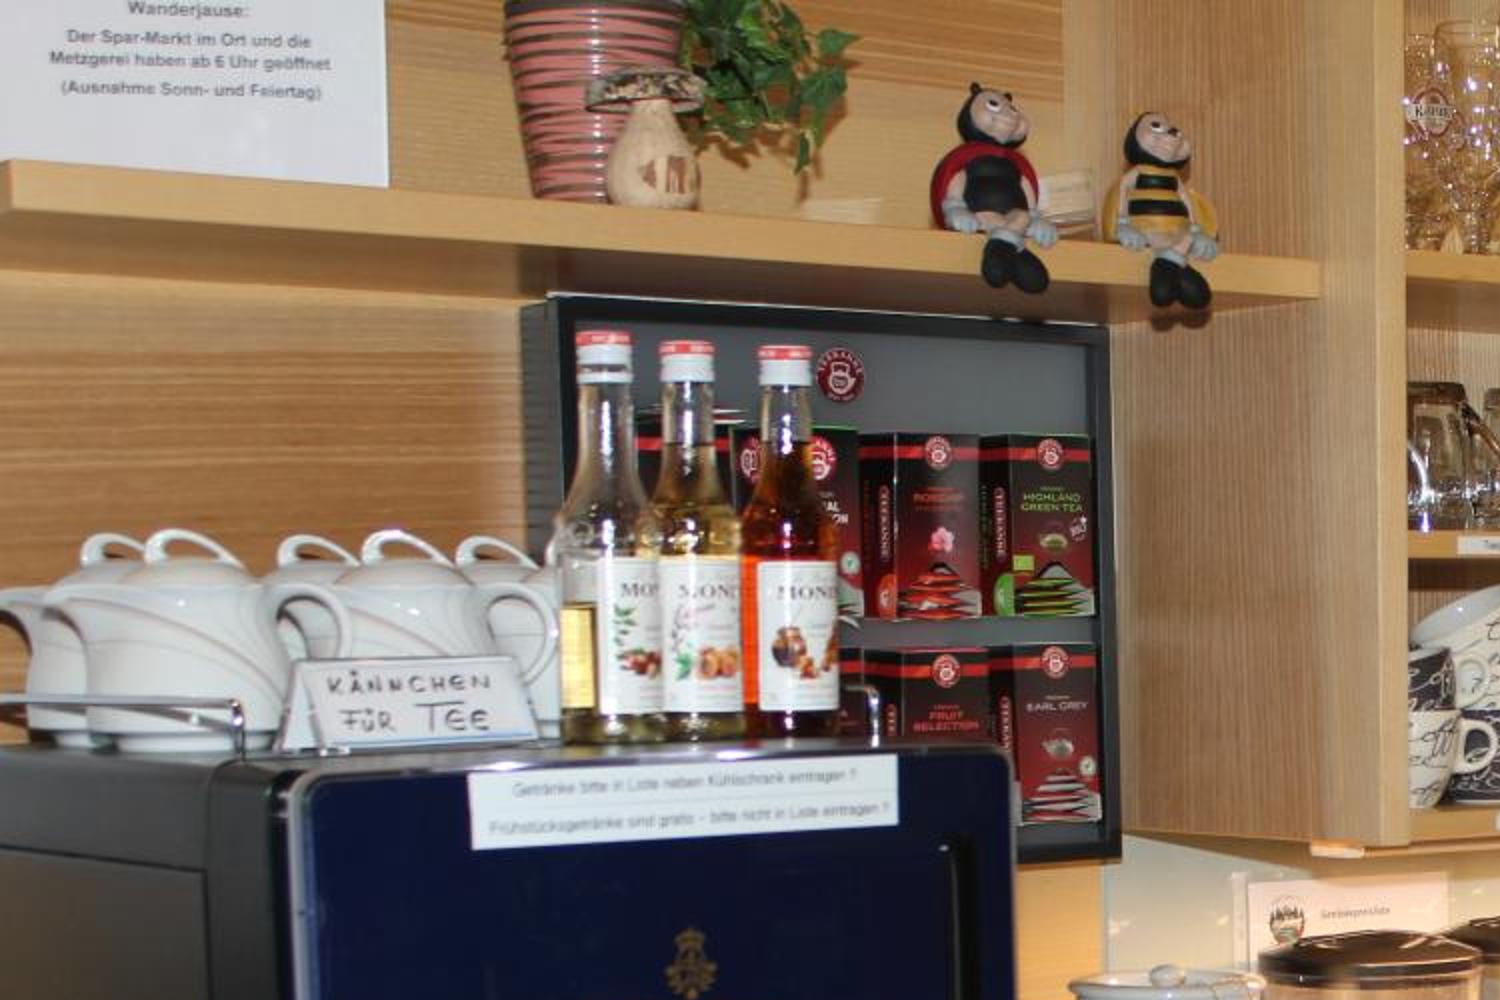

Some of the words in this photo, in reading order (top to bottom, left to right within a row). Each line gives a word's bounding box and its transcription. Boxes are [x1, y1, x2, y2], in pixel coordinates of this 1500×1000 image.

[67, 28, 97, 44] Der
[101, 29, 191, 46] Spar-Markt
[197, 33, 216, 47] im
[221, 32, 246, 47] Ort
[251, 35, 282, 48] und
[287, 35, 311, 49] die
[48, 50, 130, 68] Metzgerei
[135, 54, 185, 67] haben
[191, 55, 210, 69] ab
[229, 55, 258, 69] Uhr
[263, 57, 330, 73] geöffnet
[61, 80, 156, 96] (Ausnahme
[214, 83, 245, 97] und
[1020, 502, 1060, 513] GREEN
[1062, 502, 1083, 513] TEA
[1022, 492, 1082, 503] HIGHLAND
[326, 669, 491, 696] KÄNNCHEN
[339, 707, 398, 733] FÜR
[414, 700, 490, 732] TEE
